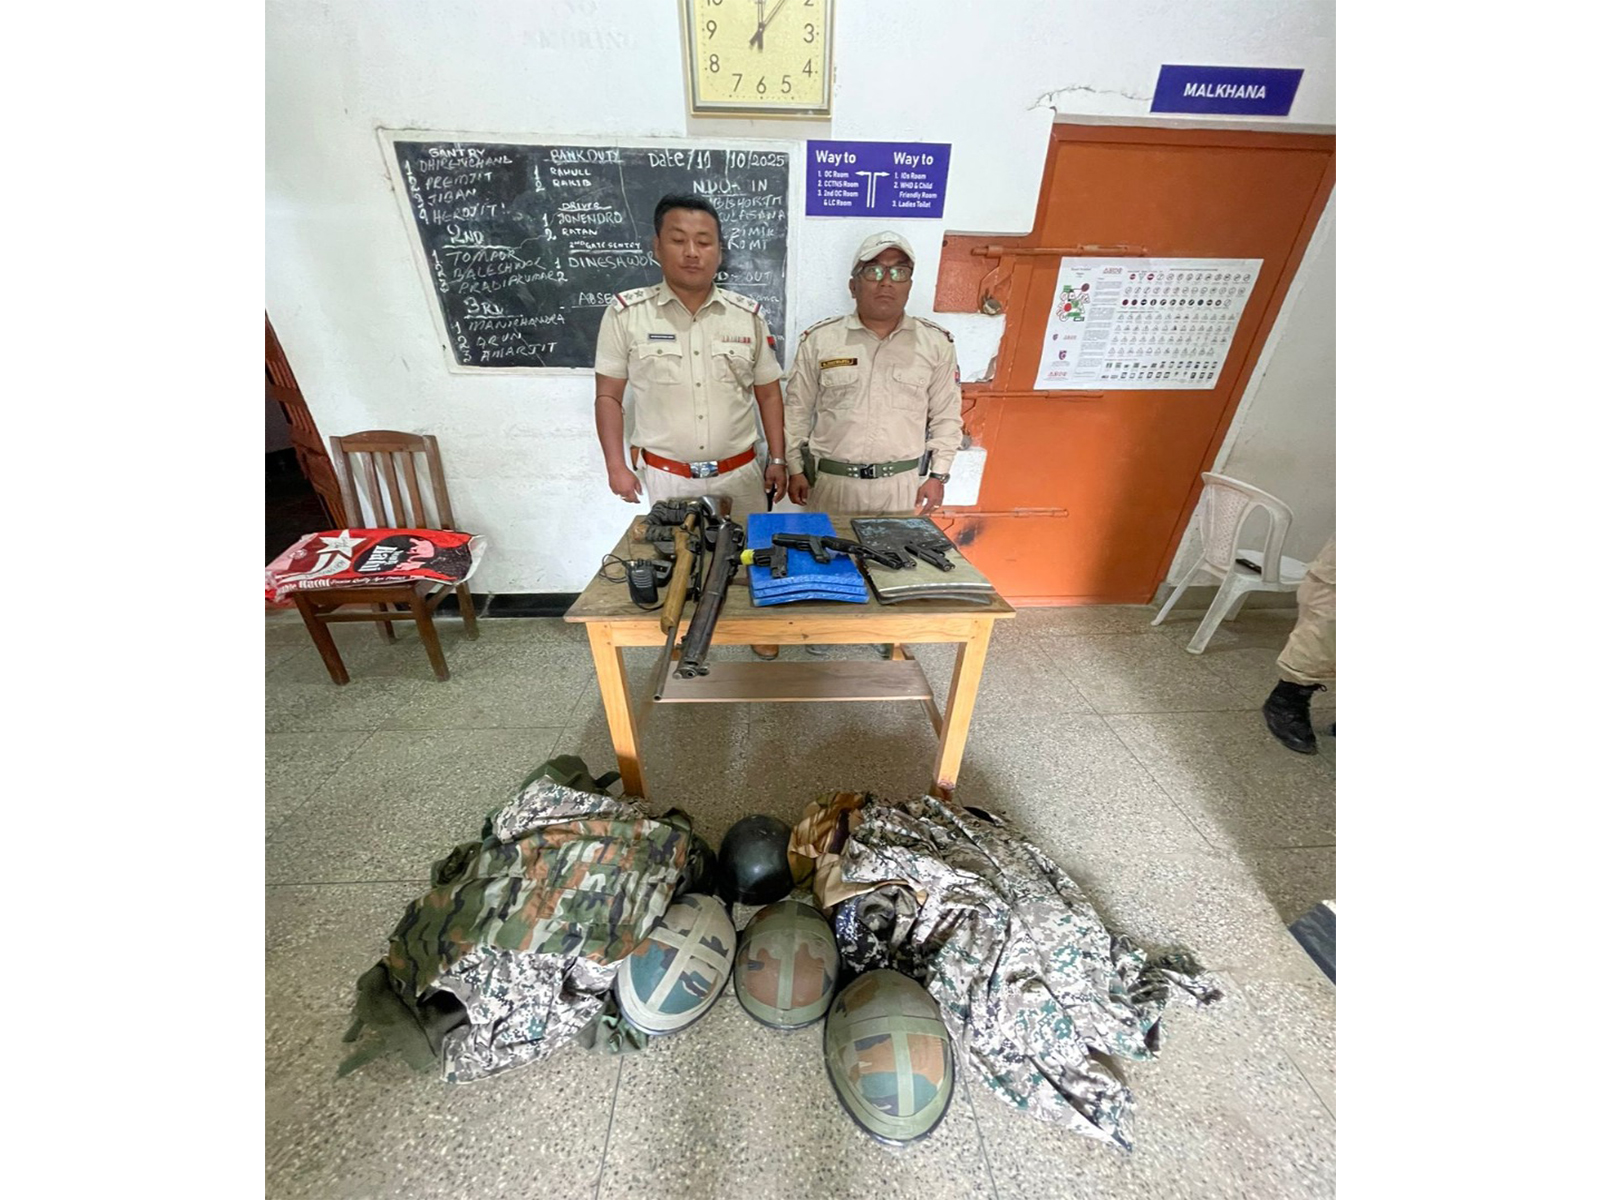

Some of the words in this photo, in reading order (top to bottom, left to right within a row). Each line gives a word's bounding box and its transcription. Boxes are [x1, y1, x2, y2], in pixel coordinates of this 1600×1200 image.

[706, 20, 717, 40] 9
[803, 23, 815, 43] 3
[709, 53, 720, 73] 8
[802, 58, 813, 78] 4
[732, 73, 743, 92] 7
[756, 76, 767, 94] 6
[781, 75, 792, 94] 5
[1183, 82, 1266, 99] MALKHANA
[550, 149, 588, 163] BANK
[587, 149, 619, 163] DUTY
[816, 150, 842, 166] Way
[844, 152, 857, 164] to
[893, 152, 920, 168] Way
[921, 154, 934, 166] to
[833, 170, 849, 178] Room
[910, 172, 927, 180] Room
[842, 180, 860, 188] Room
[918, 182, 933, 190] Child
[823, 189, 834, 197] 2nd
[899, 190, 921, 200] Friendly
[921, 191, 938, 199] Room
[836, 199, 852, 207] Room
[898, 200, 916, 208] Ladies
[916, 200, 931, 208] Toilet
[562, 228, 598, 236] RATAN
